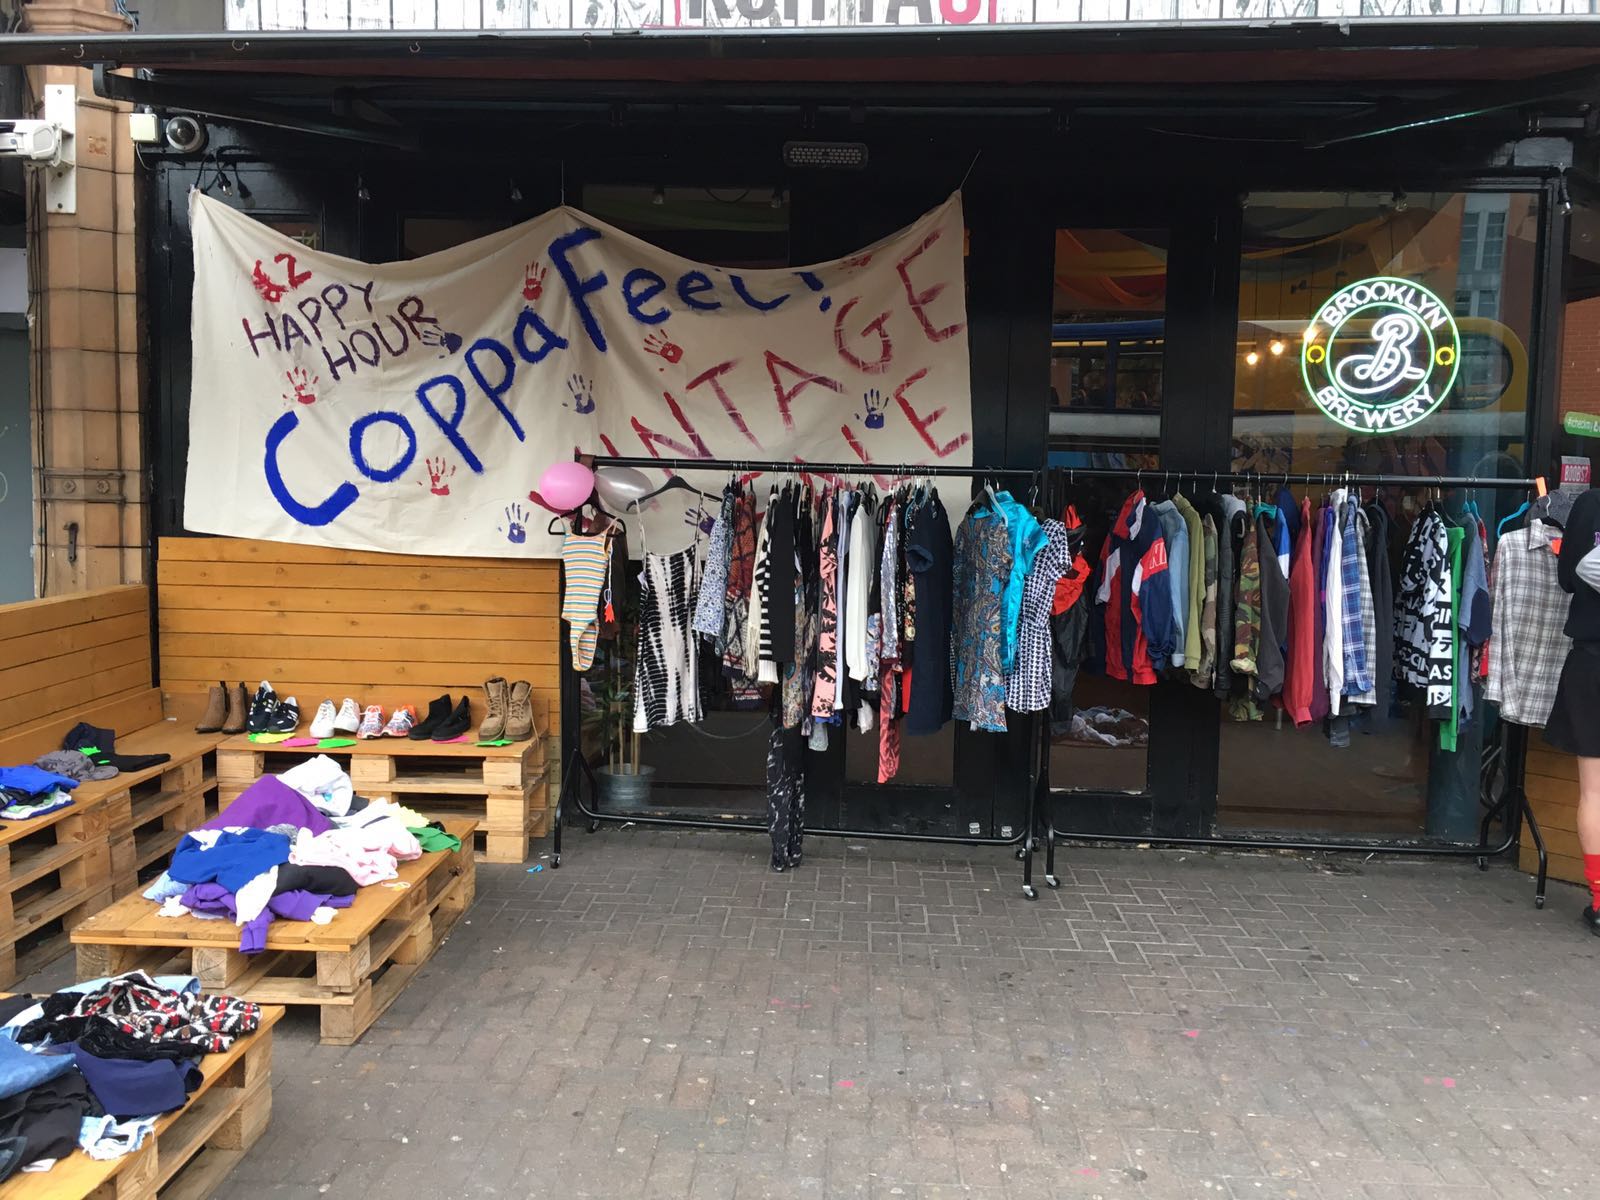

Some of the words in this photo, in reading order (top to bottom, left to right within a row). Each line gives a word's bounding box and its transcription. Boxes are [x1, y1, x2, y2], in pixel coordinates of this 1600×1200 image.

[242, 281, 374, 356] HAPPY
[1321, 281, 1448, 329] BROOKLYN
[322, 296, 438, 380] HOUR
[1317, 383, 1435, 428] BREWERY
